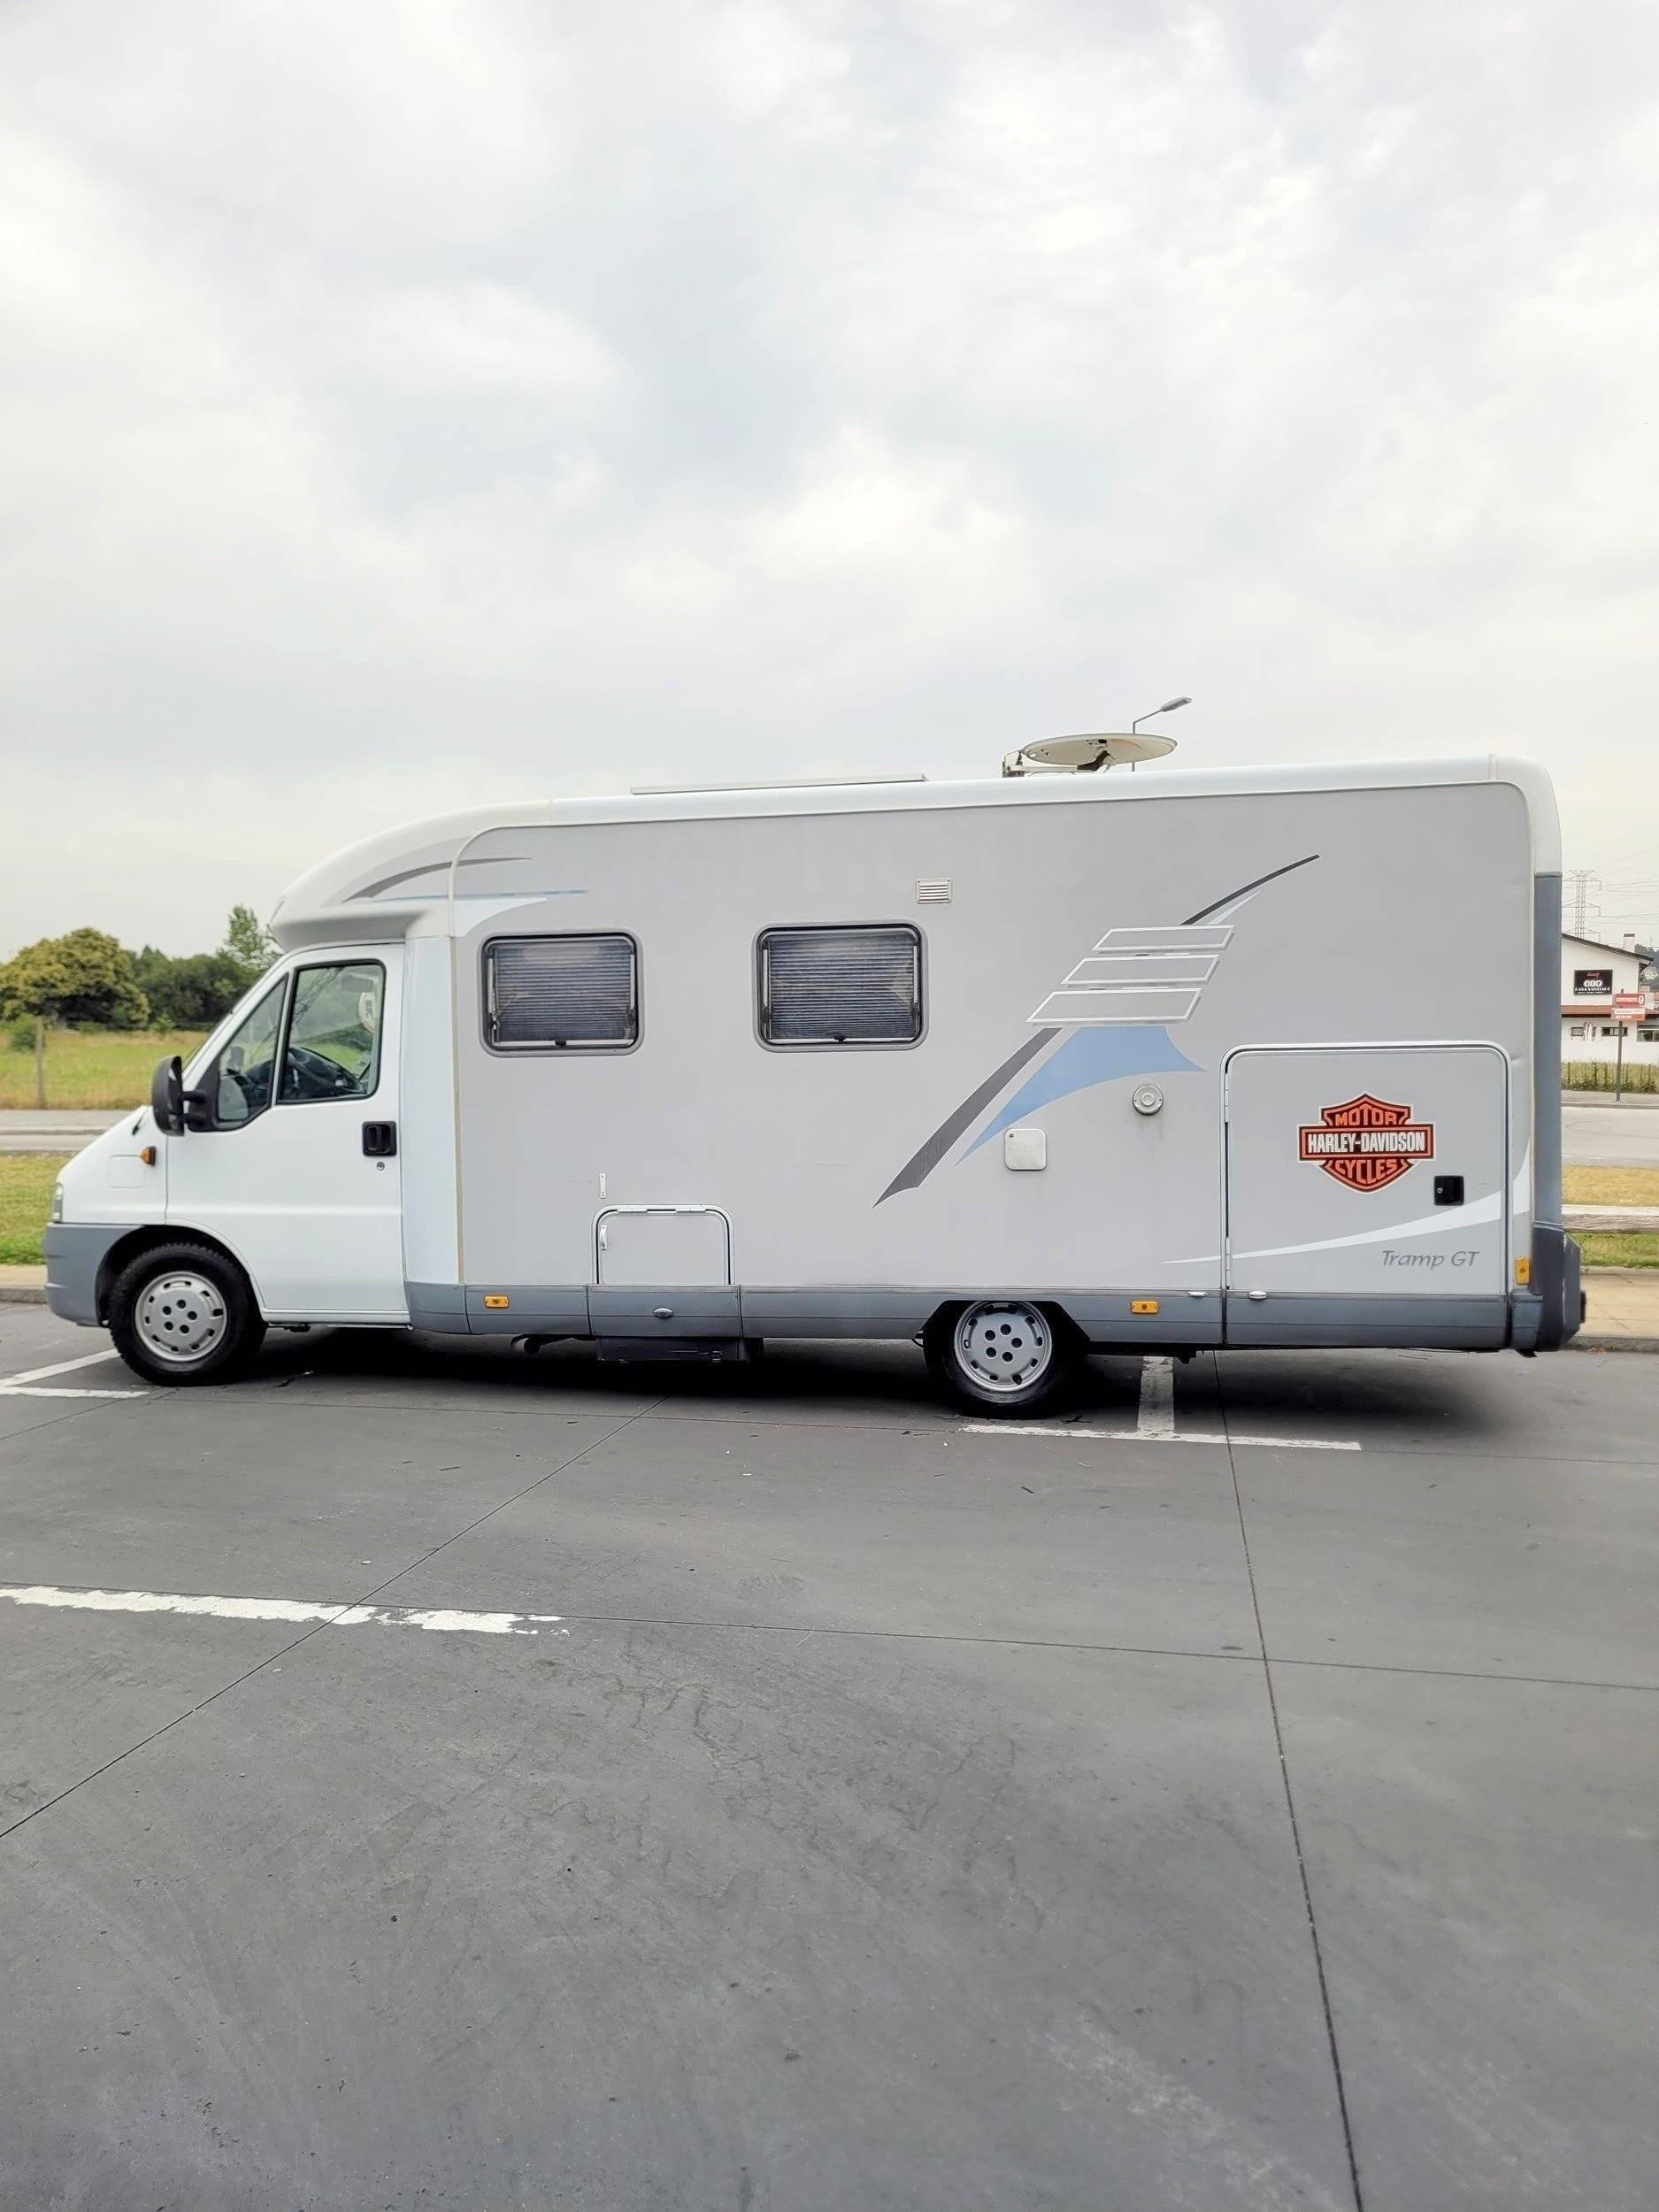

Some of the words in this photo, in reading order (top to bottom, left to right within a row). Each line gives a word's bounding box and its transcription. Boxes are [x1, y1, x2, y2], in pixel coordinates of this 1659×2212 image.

[1334, 1103, 1398, 1126] MOTOR
[1308, 1132, 1425, 1154] HARLEY-DAVIDSON
[1334, 1158, 1399, 1185] CYCLES
[1382, 1249, 1445, 1271] Tramp
[1450, 1249, 1480, 1267] GT
